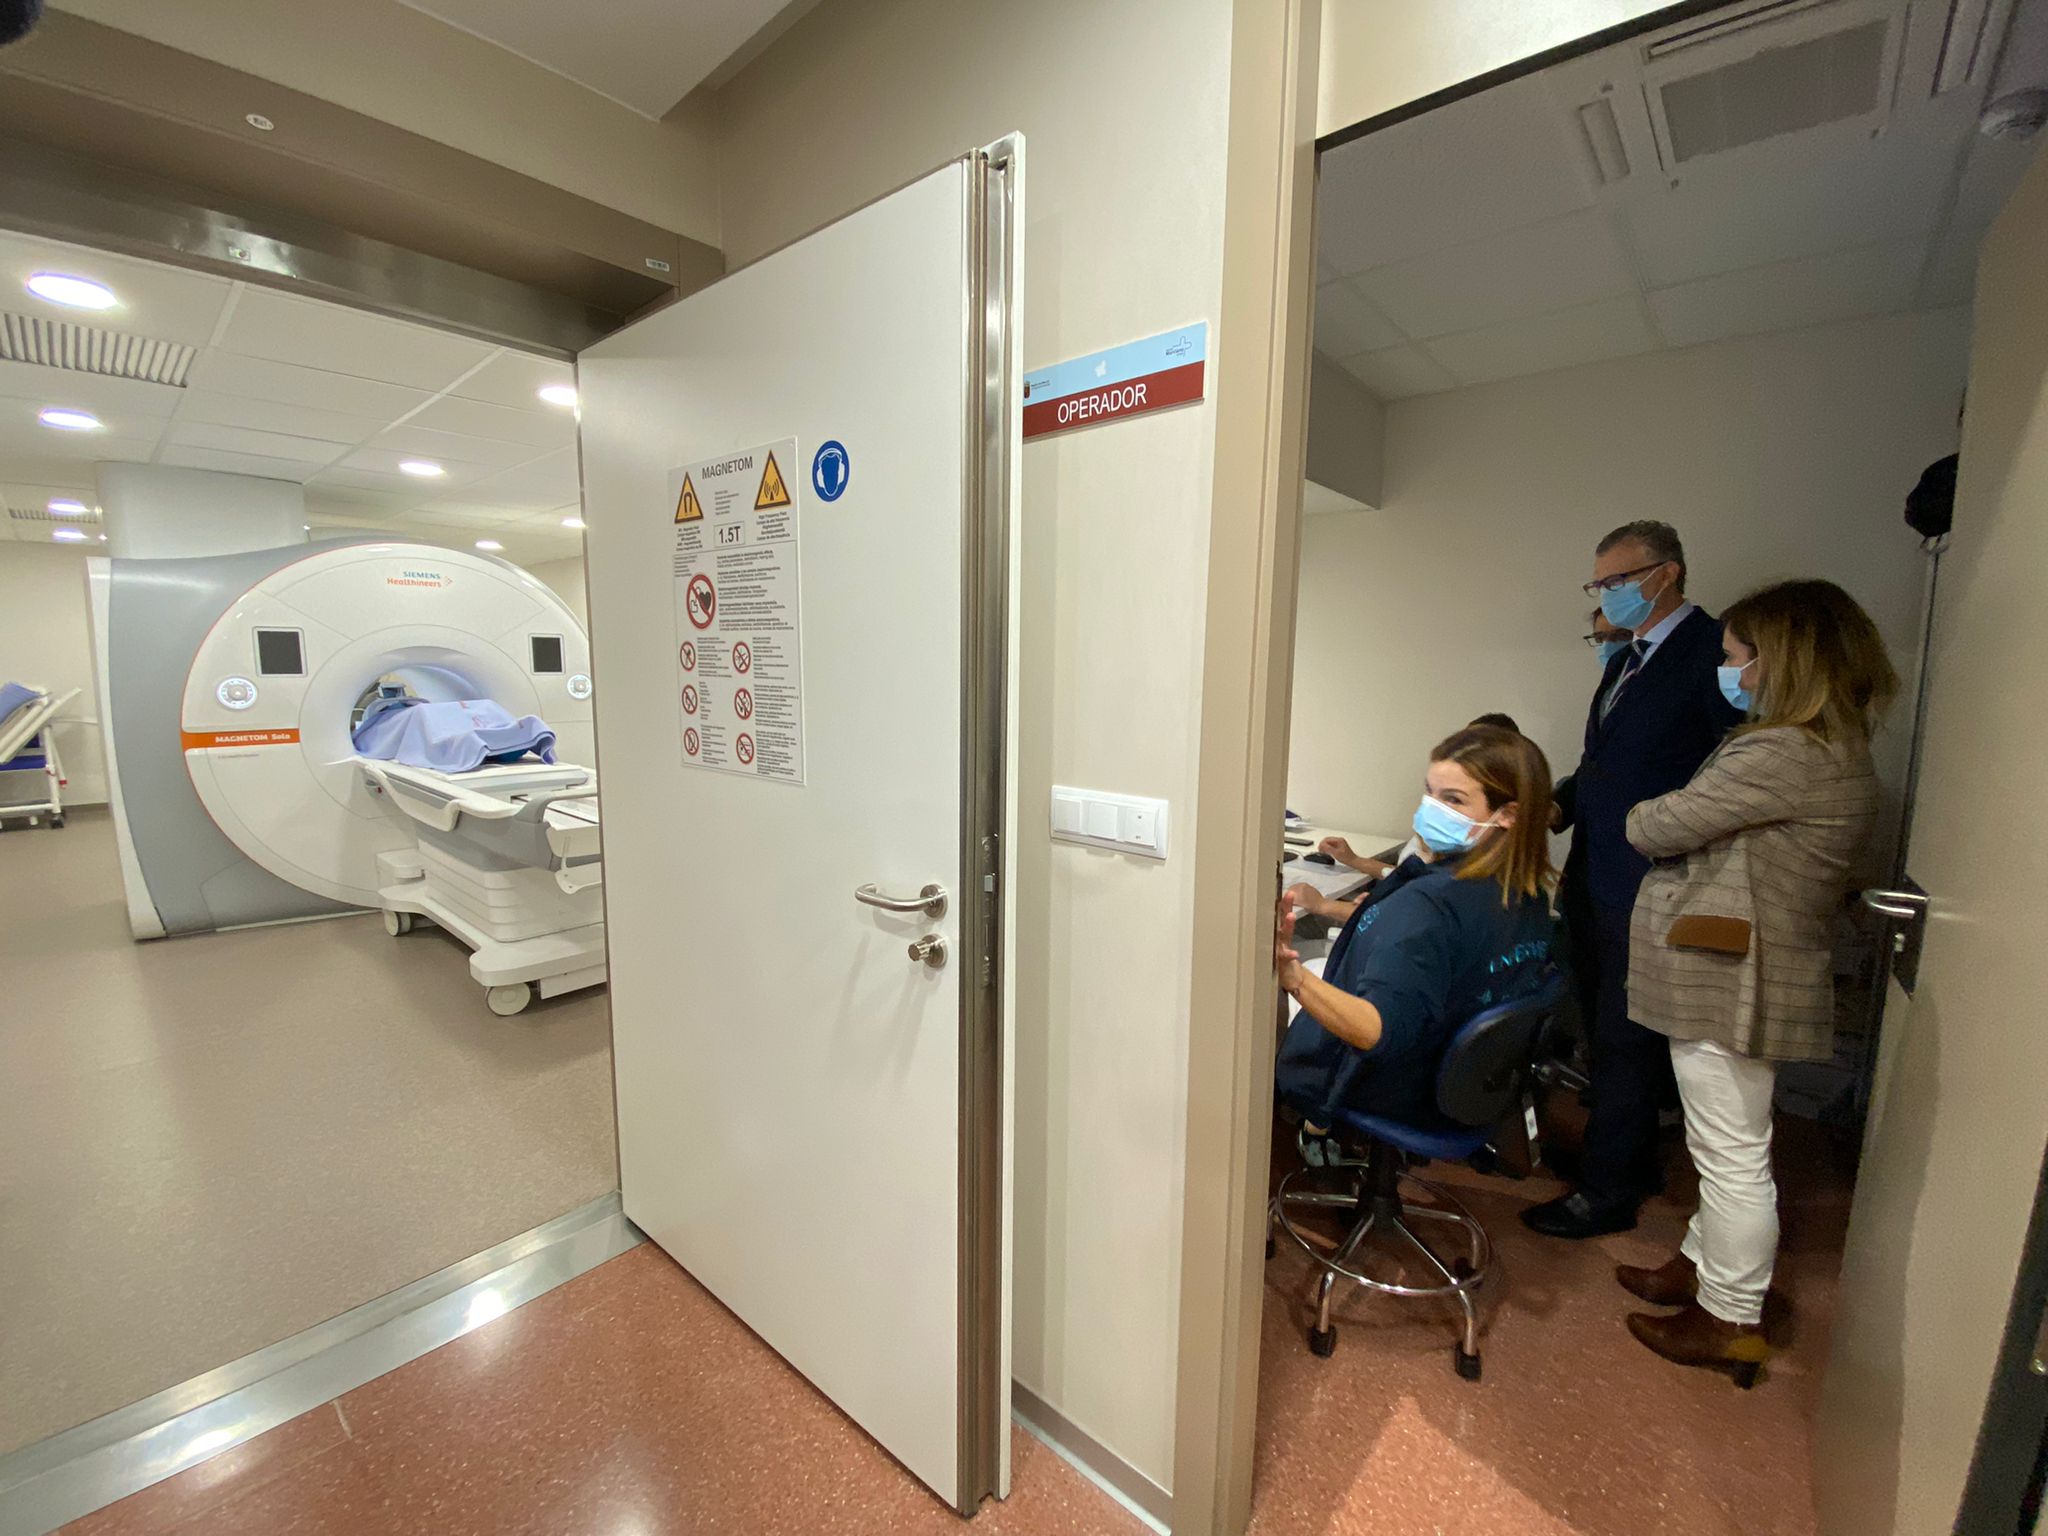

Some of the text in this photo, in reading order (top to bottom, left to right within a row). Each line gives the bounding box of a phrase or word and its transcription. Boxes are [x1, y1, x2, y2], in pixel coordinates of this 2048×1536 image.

[1057, 383, 1147, 424] OPERADOR
[702, 456, 753, 479] MAGNETOM
[718, 526, 741, 544] 1.5T
[402, 571, 441, 579] SIEMENS
[386, 577, 442, 588] Healthineers
[215, 734, 268, 743] MAGNETOM
